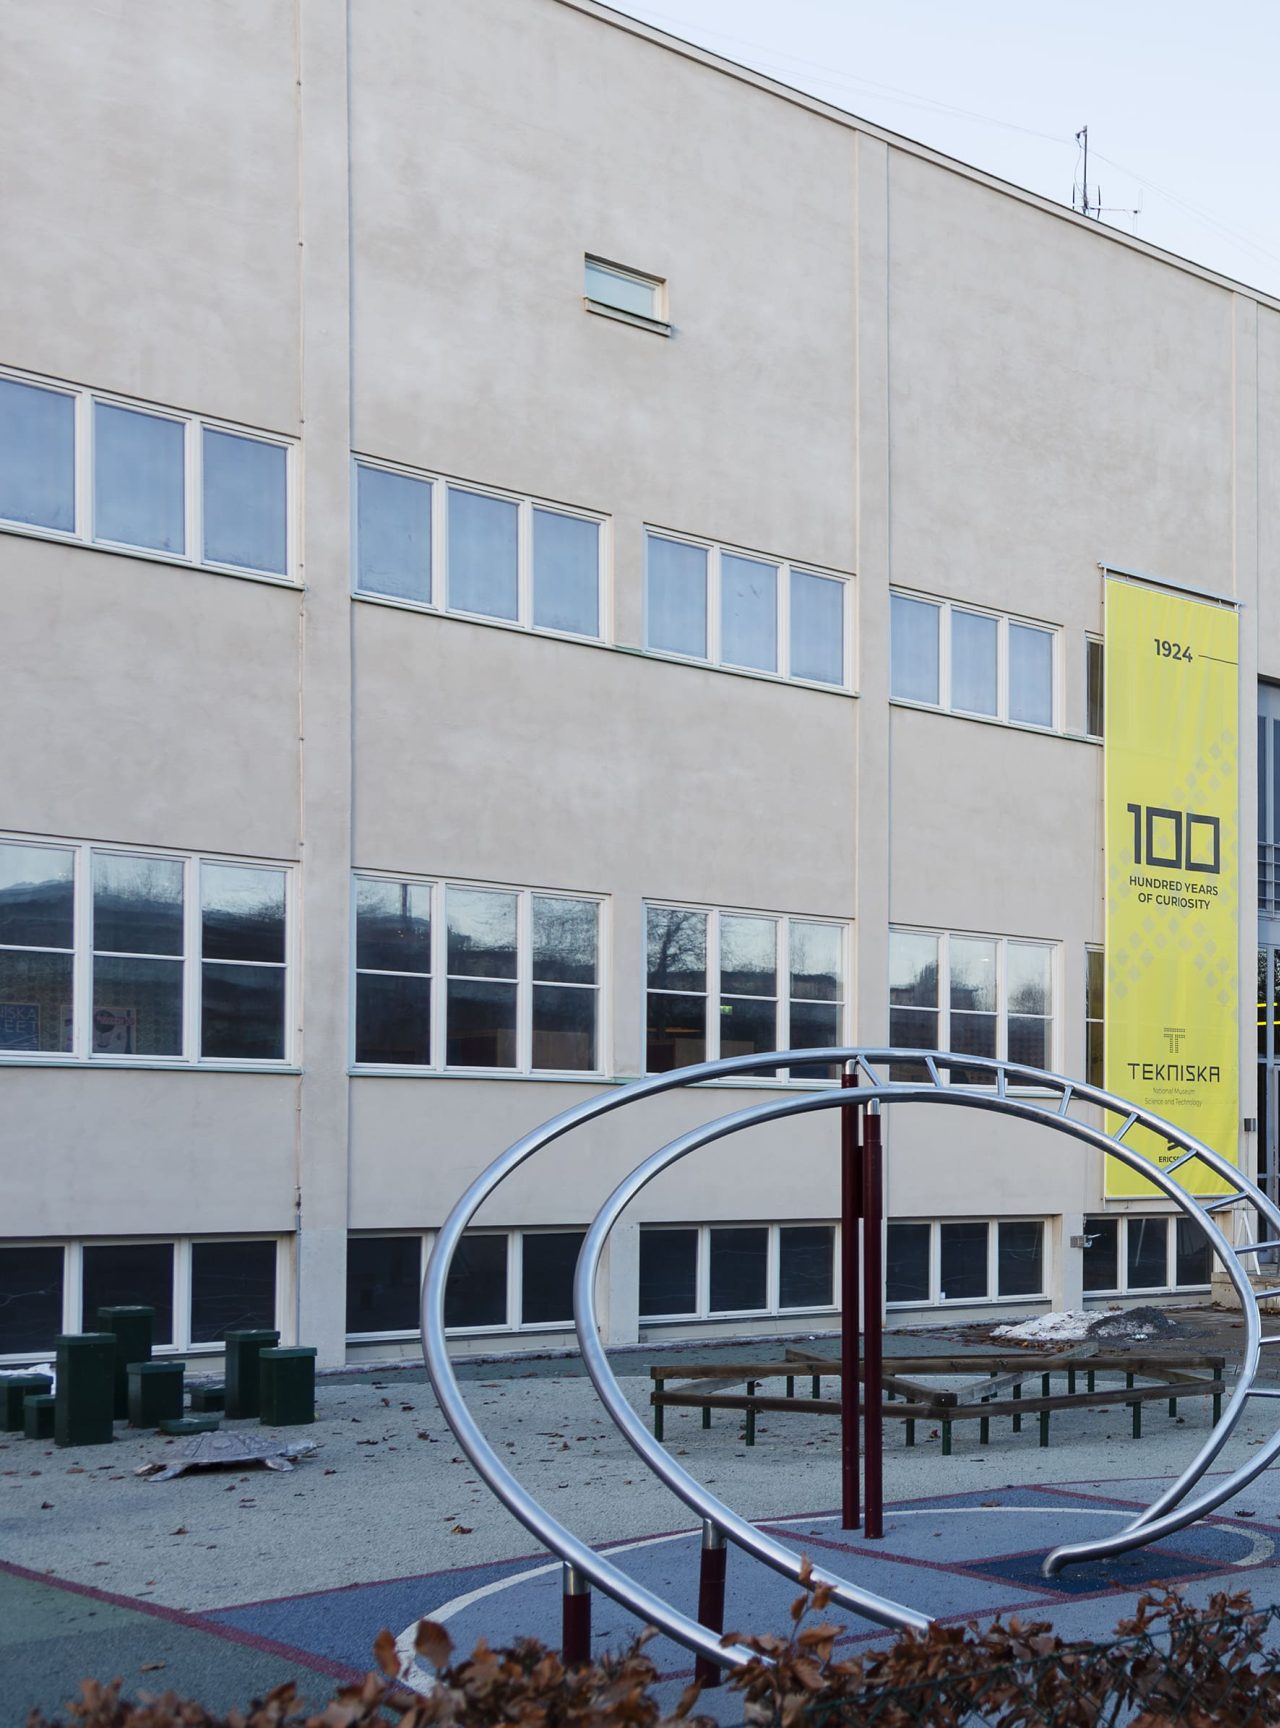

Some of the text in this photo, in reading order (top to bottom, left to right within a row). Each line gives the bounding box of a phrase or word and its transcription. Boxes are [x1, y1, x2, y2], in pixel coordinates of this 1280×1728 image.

[1153, 638, 1193, 662] 1924
[1127, 803, 1220, 874] 100
[1129, 875, 1219, 896] HUNDRED YEARS
[1138, 892, 1210, 910] OF CURIOSITY
[1127, 1063, 1220, 1083] TEKNISKA
